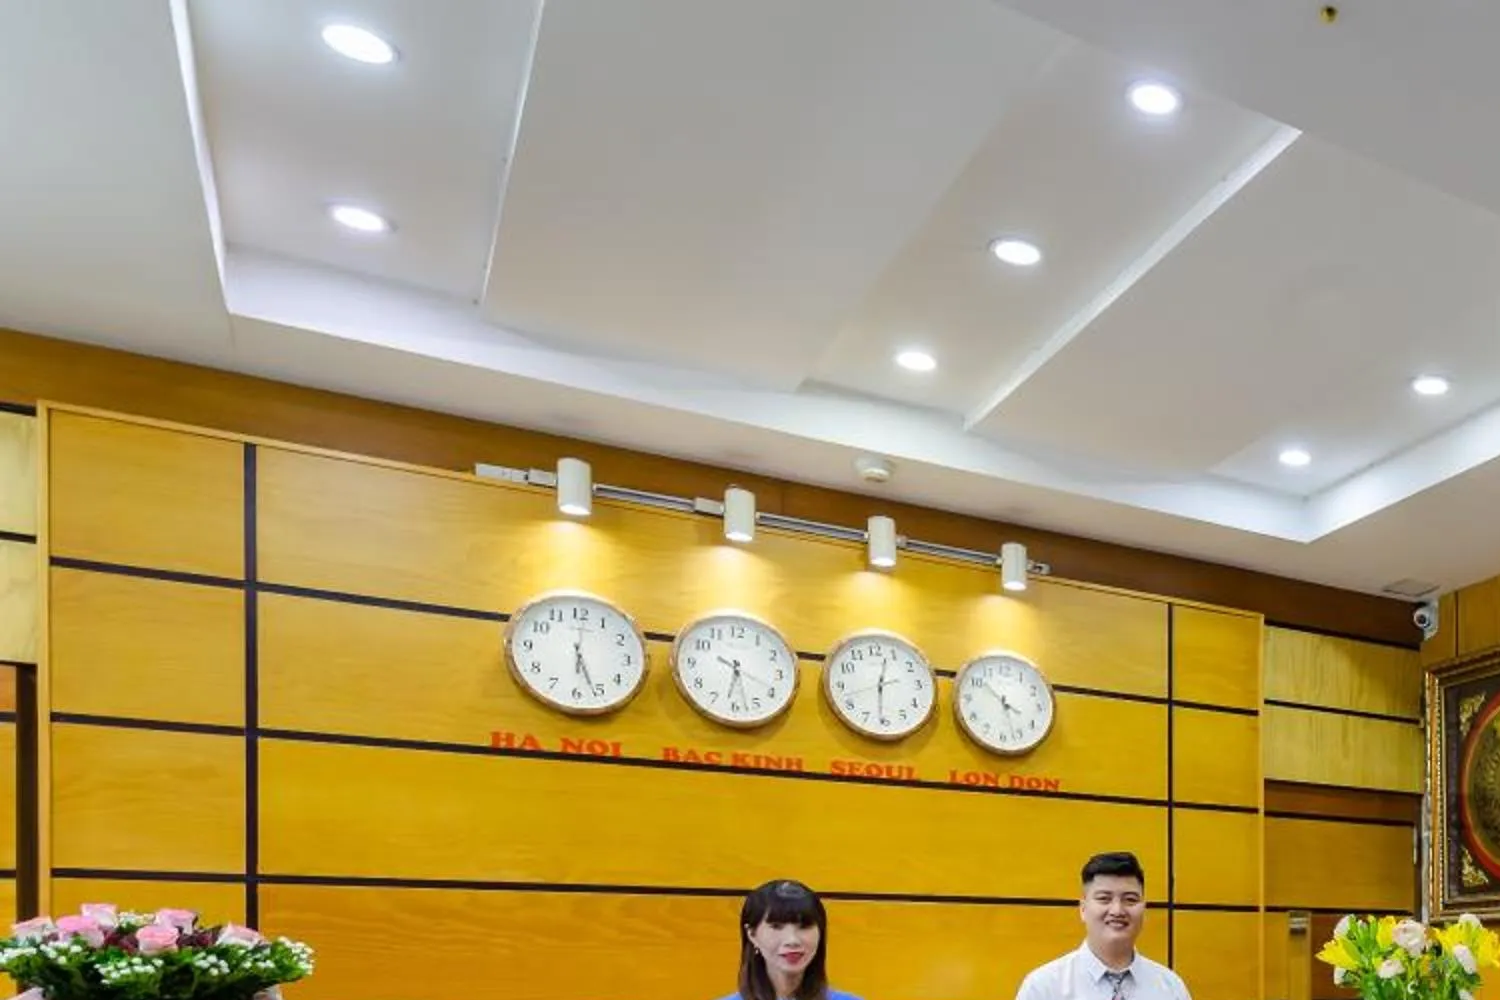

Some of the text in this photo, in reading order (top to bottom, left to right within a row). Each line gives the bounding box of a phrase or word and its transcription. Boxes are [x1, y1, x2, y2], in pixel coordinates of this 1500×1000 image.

[550, 608, 563, 622] 11
[572, 607, 589, 621] 12
[533, 621, 550, 634] 10
[600, 617, 605, 629] 1
[710, 627, 722, 641] 11
[730, 625, 745, 639] 12
[523, 639, 533, 652] 9
[615, 634, 625, 647] 2
[696, 639, 711, 651] 10
[755, 634, 761, 646] 1
[769, 649, 777, 661] 2
[851, 649, 863, 661] 11
[868, 645, 882, 657] 12
[891, 649, 897, 661] 1
[621, 653, 631, 666] 3
[687, 657, 697, 669] 9
[531, 661, 541, 673] 8
[840, 663, 855, 674] 10
[905, 661, 915, 673] 2
[613, 673, 621, 685] 4
[775, 669, 784, 681] 3
[549, 677, 559, 689] 7
[694, 677, 703, 688] 8
[836, 681, 845, 691] 9
[915, 679, 923, 691] 3
[571, 688, 582, 699] 6
[594, 684, 605, 697] 5
[767, 687, 775, 699] 4
[709, 692, 719, 703] 7
[752, 698, 761, 709] 5
[911, 697, 919, 709] 4
[731, 702, 740, 713] 6
[845, 700, 855, 710] 8
[862, 712, 870, 722] 7
[899, 709, 907, 720] 5
[491, 731, 622, 757] HA NOI
[663, 747, 802, 772] BAC KINH
[831, 761, 915, 780] SEOUL
